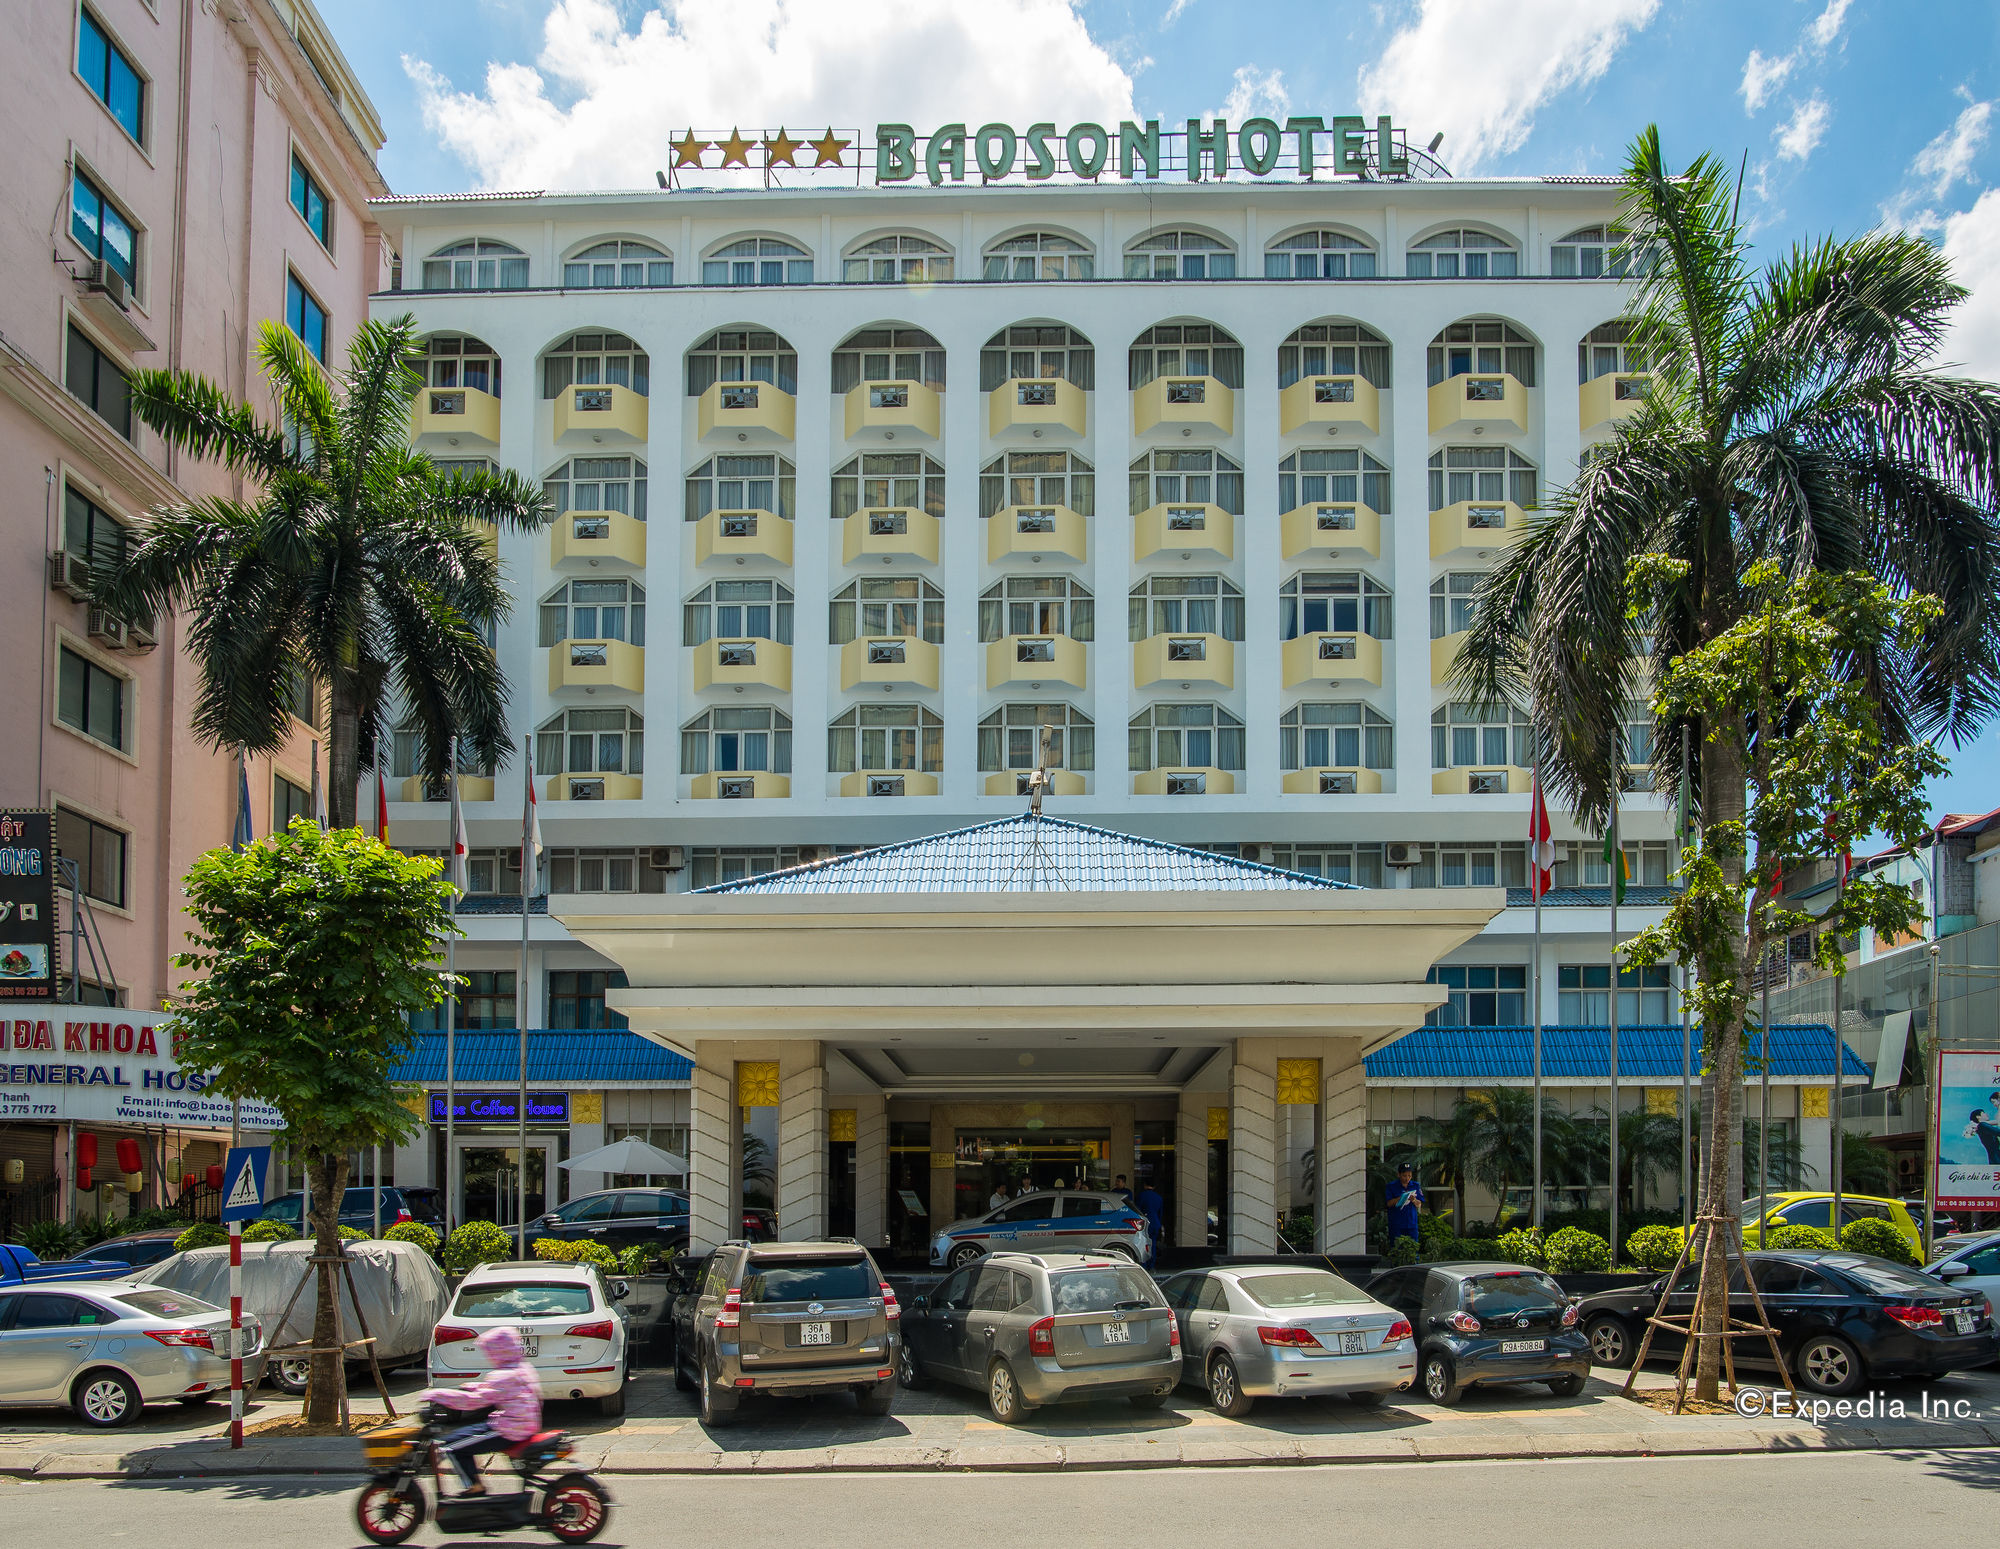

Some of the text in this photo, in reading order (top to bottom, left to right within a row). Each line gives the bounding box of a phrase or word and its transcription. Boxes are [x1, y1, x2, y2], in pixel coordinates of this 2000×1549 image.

[1187, 116, 1409, 181] HOTEL
[14, 1020, 52, 1049] ĐA
[64, 1022, 158, 1056] KHOA
[11, 1104, 29, 1114] 775
[32, 1104, 56, 1114] 7172
[470, 1099, 515, 1116] Coffee
[116, 1107, 174, 1120] Website:
[807, 1323, 824, 1333] 36A
[1108, 1322, 1123, 1333] 29A
[803, 1333, 831, 1344] 138.18
[1345, 1333, 1361, 1344] 30H
[1345, 1343, 1364, 1353] 8814
